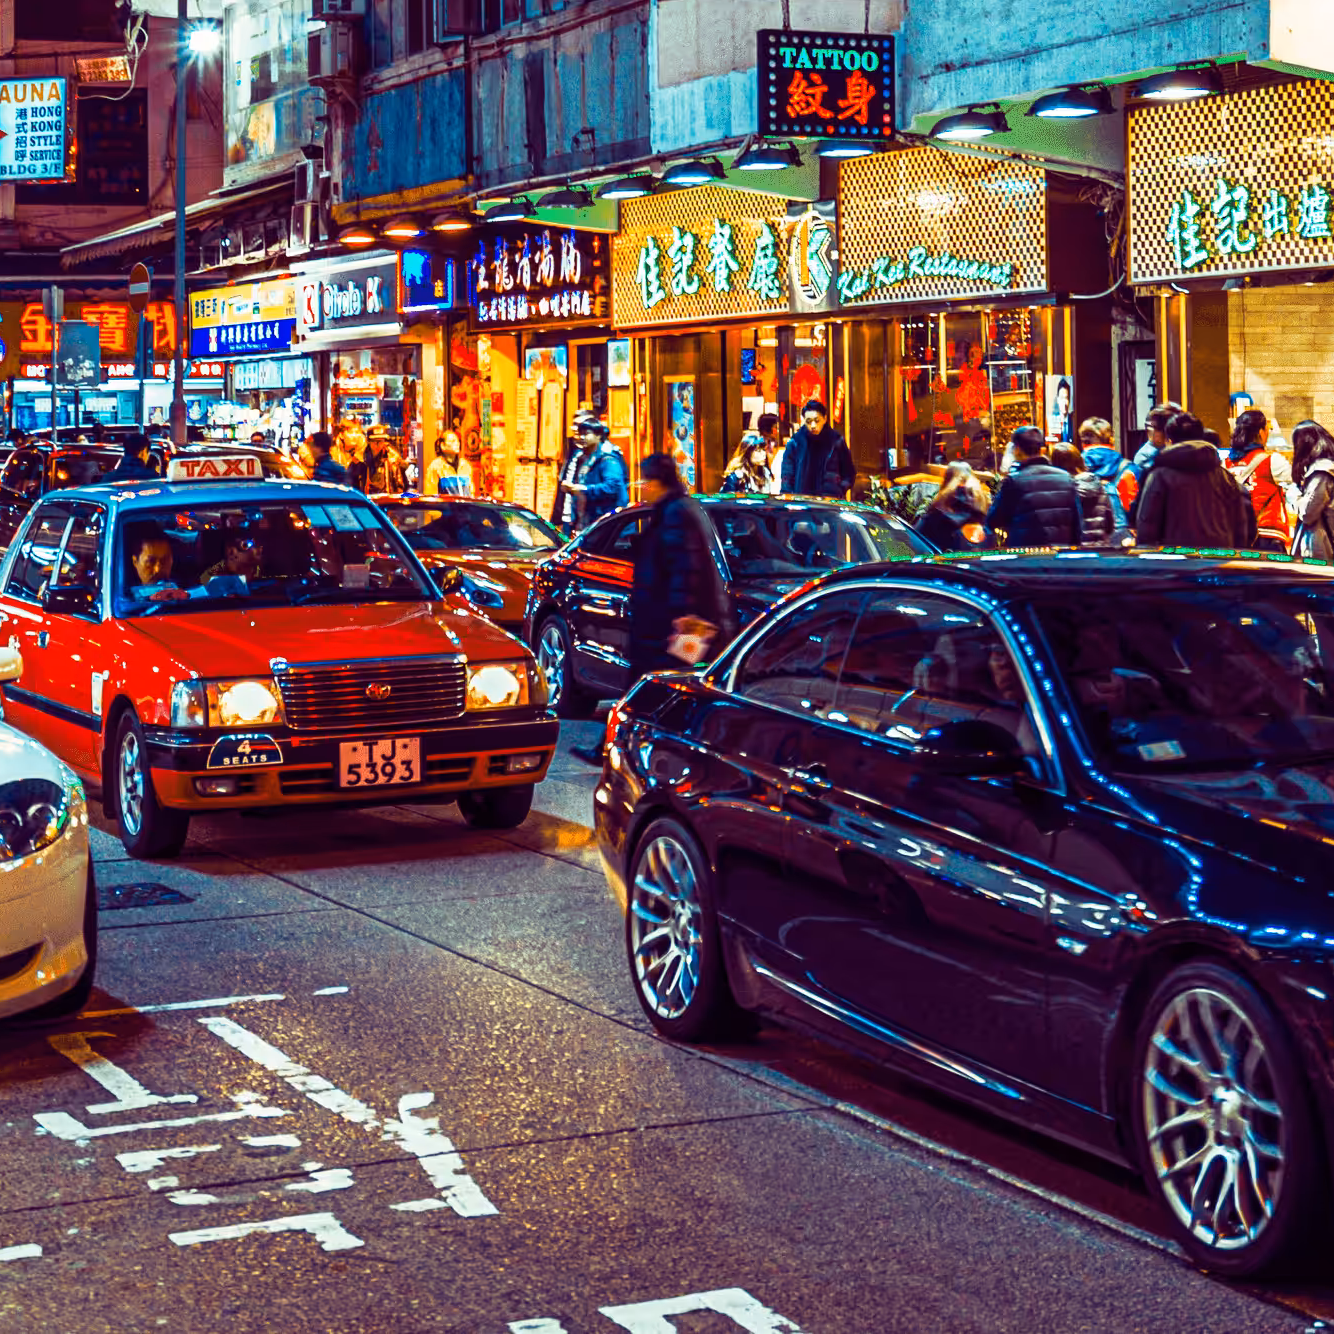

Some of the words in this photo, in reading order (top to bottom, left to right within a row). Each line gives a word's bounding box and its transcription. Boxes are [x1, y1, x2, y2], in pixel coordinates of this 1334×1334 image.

[779, 47, 880, 72] TATTOO
[786, 70, 877, 124] 紋身
[31, 106, 62, 118] HONG
[30, 120, 62, 133] KONG
[30, 135, 62, 147] STYLE
[30, 149, 62, 162] SERVICE
[0, 164, 37, 176] BLDG
[41, 162, 62, 175] 3/F
[366, 276, 383, 314] K
[183, 457, 256, 477] TAXI
[237, 739, 252, 755] 4
[363, 741, 398, 764] TJ
[223, 754, 267, 766] SEATS
[347, 760, 415, 788] 5393
